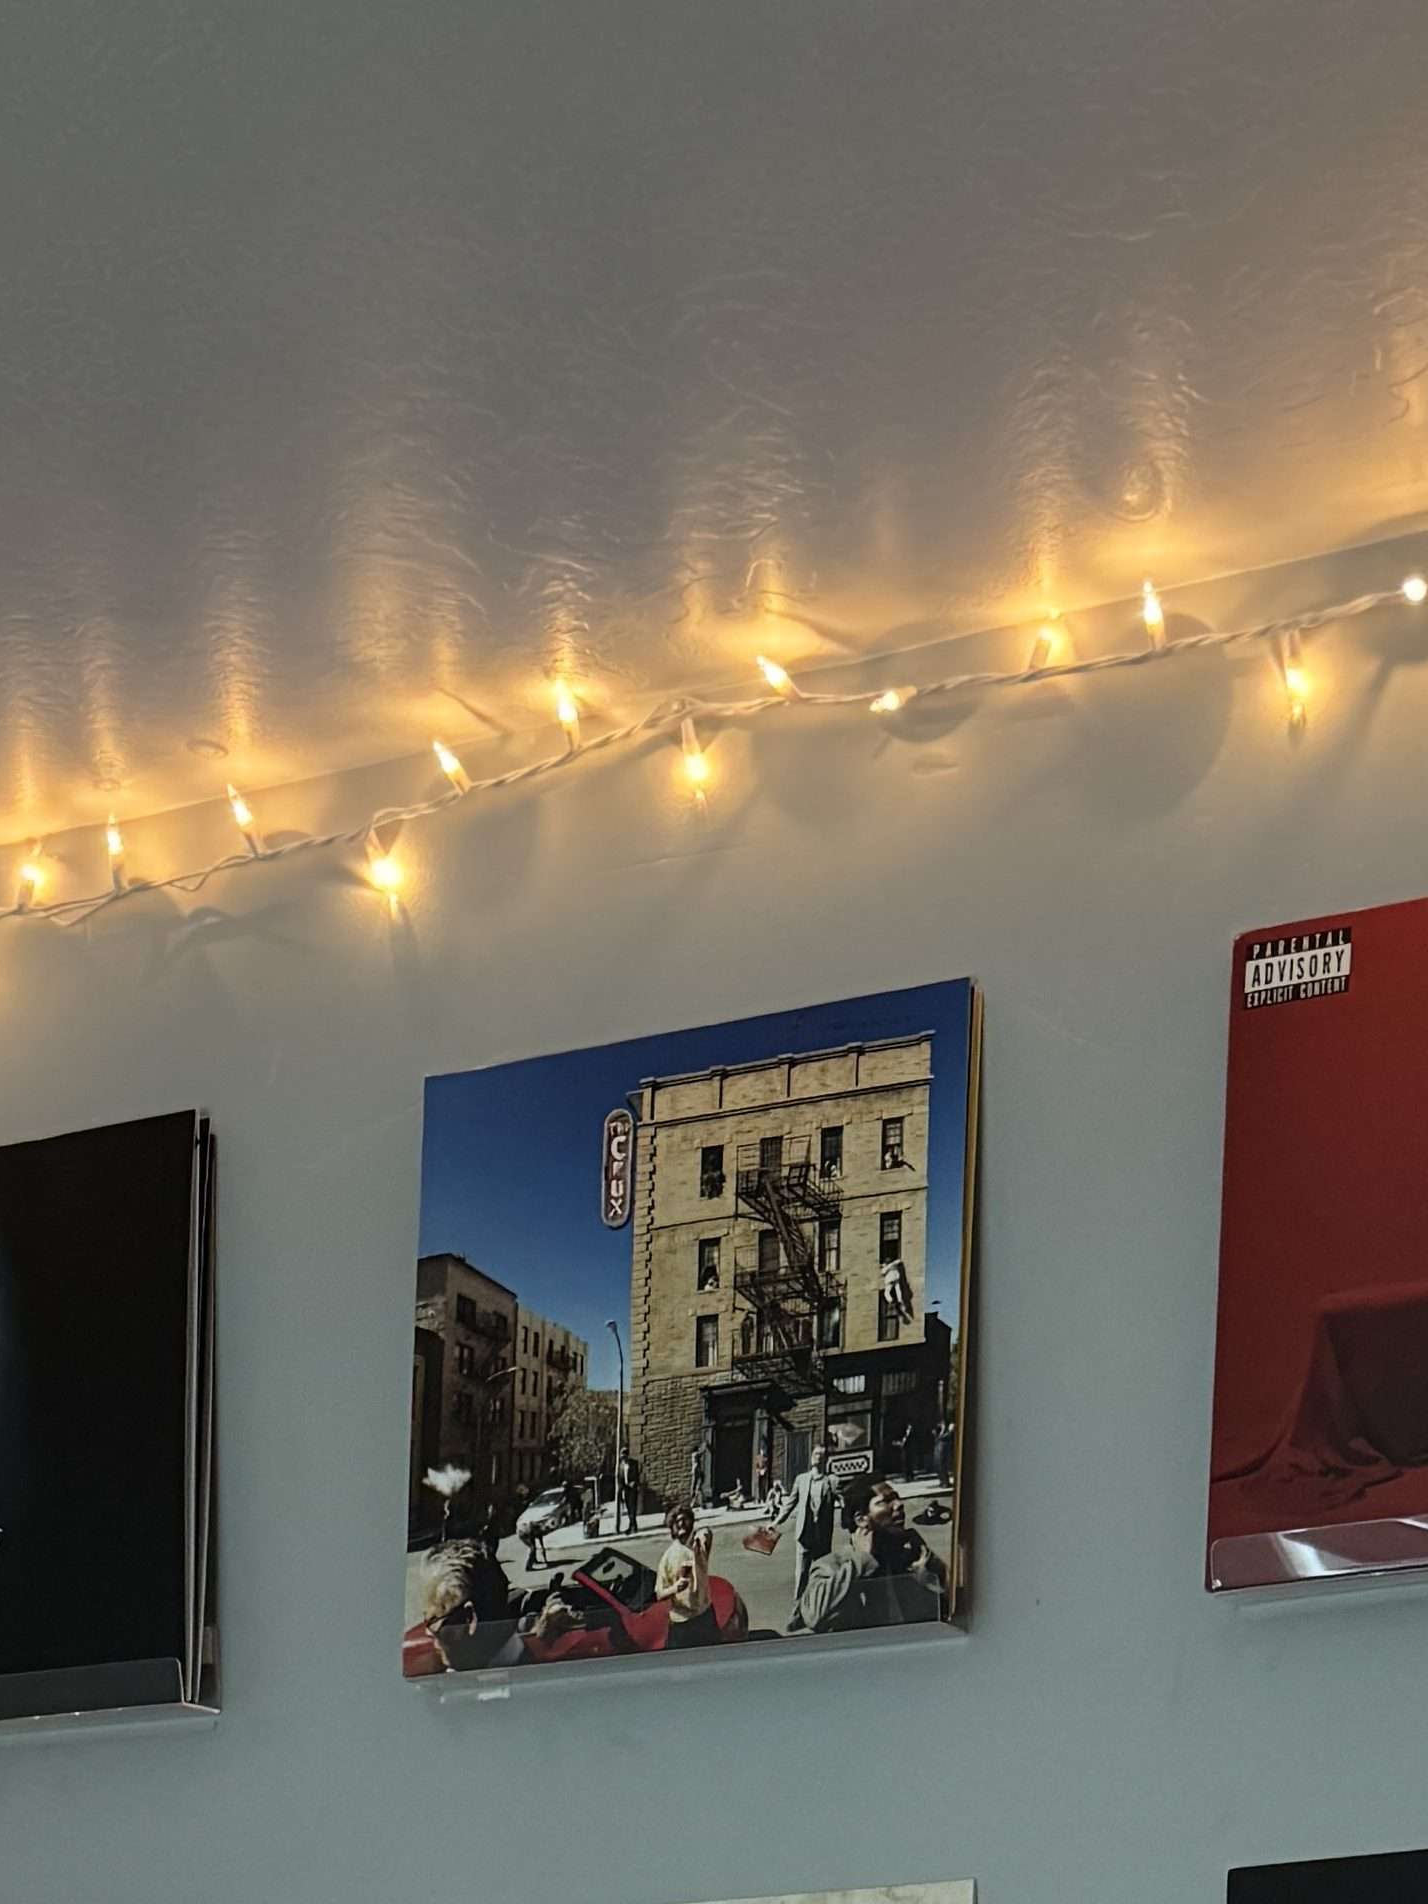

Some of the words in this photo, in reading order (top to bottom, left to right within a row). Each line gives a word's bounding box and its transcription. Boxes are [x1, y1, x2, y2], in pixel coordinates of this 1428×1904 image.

[1253, 930, 1345, 960] PARENTAL
[1252, 949, 1345, 988] ADVISORY
[1247, 985, 1293, 1009] EXPLICIT
[1299, 976, 1347, 999] CONTENT
